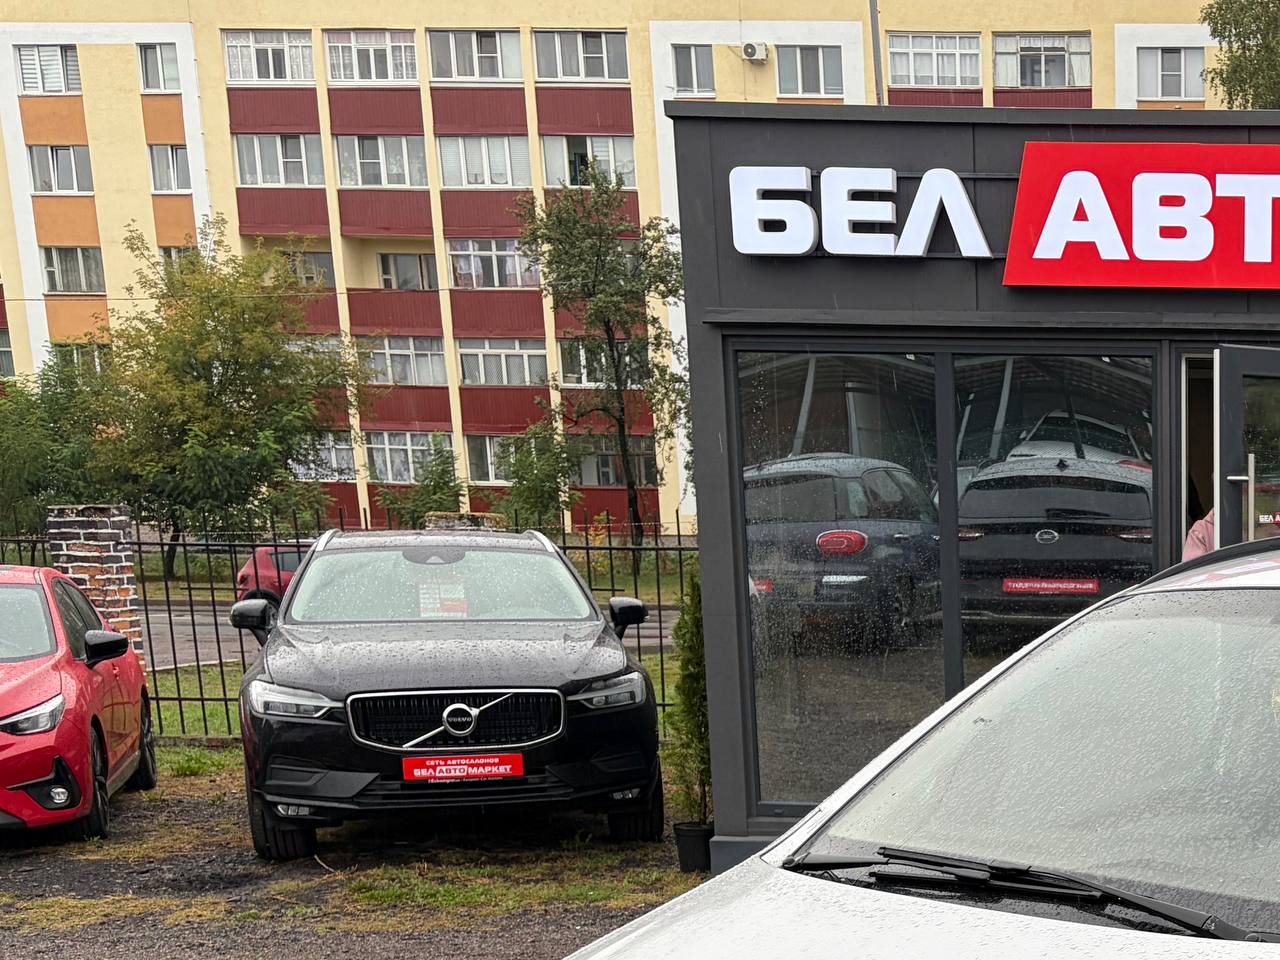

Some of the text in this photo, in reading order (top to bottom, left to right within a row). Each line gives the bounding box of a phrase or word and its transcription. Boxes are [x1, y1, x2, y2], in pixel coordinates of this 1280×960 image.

[729, 166, 994, 257] БЕЛ
[413, 765, 512, 777] БЕЛ АВТО МАРКЕТ
